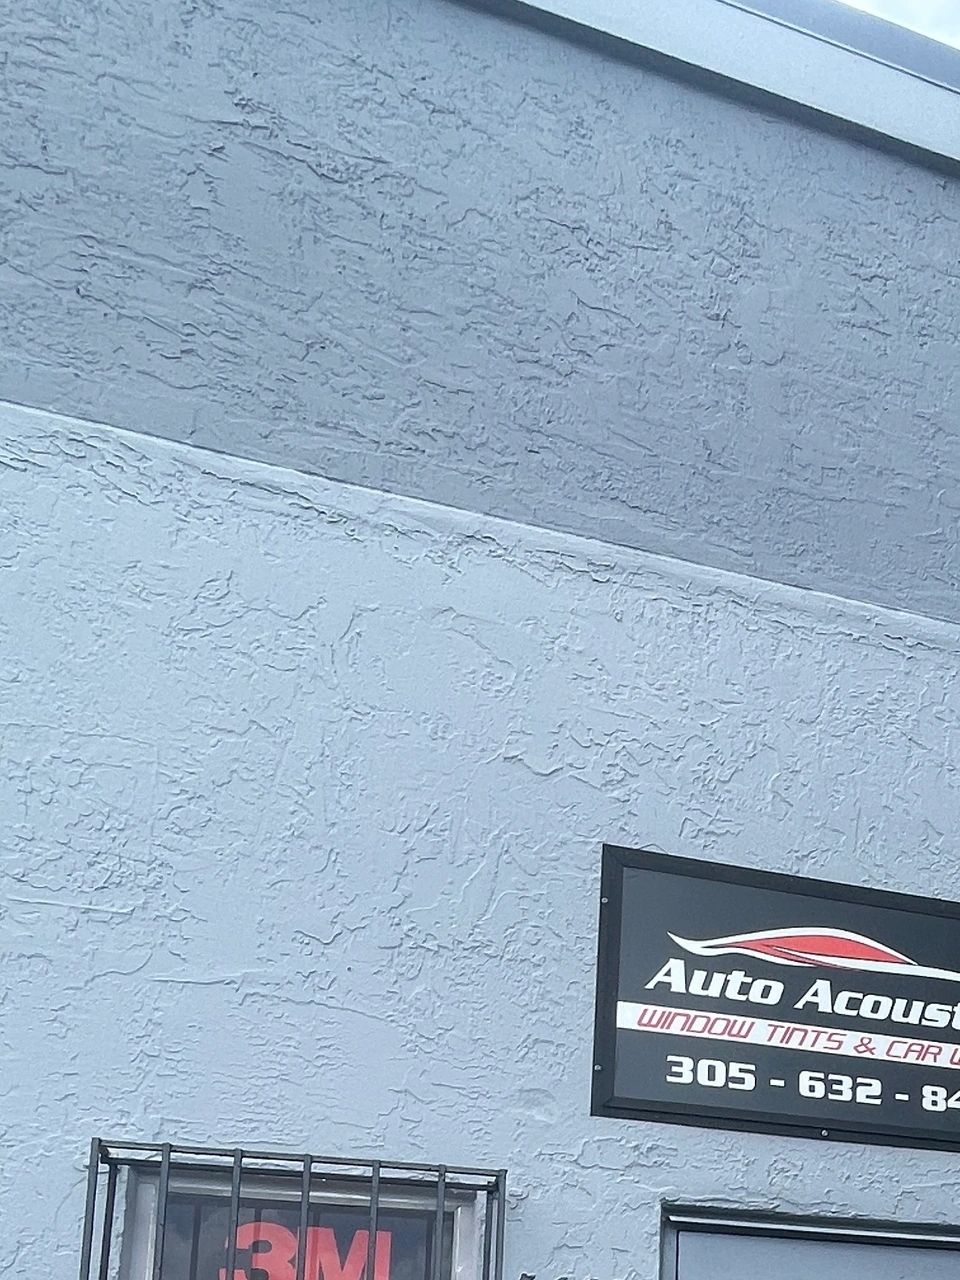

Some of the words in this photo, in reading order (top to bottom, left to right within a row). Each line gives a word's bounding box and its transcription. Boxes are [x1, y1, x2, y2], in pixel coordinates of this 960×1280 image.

[645, 959, 785, 1006] Auto
[637, 1008, 755, 1039] WINDOW
[765, 1023, 847, 1052] TINTS
[853, 1036, 877, 1056] &
[886, 1041, 943, 1064] CAR
[666, 1055, 757, 1092] 305
[798, 1070, 882, 1105] 632
